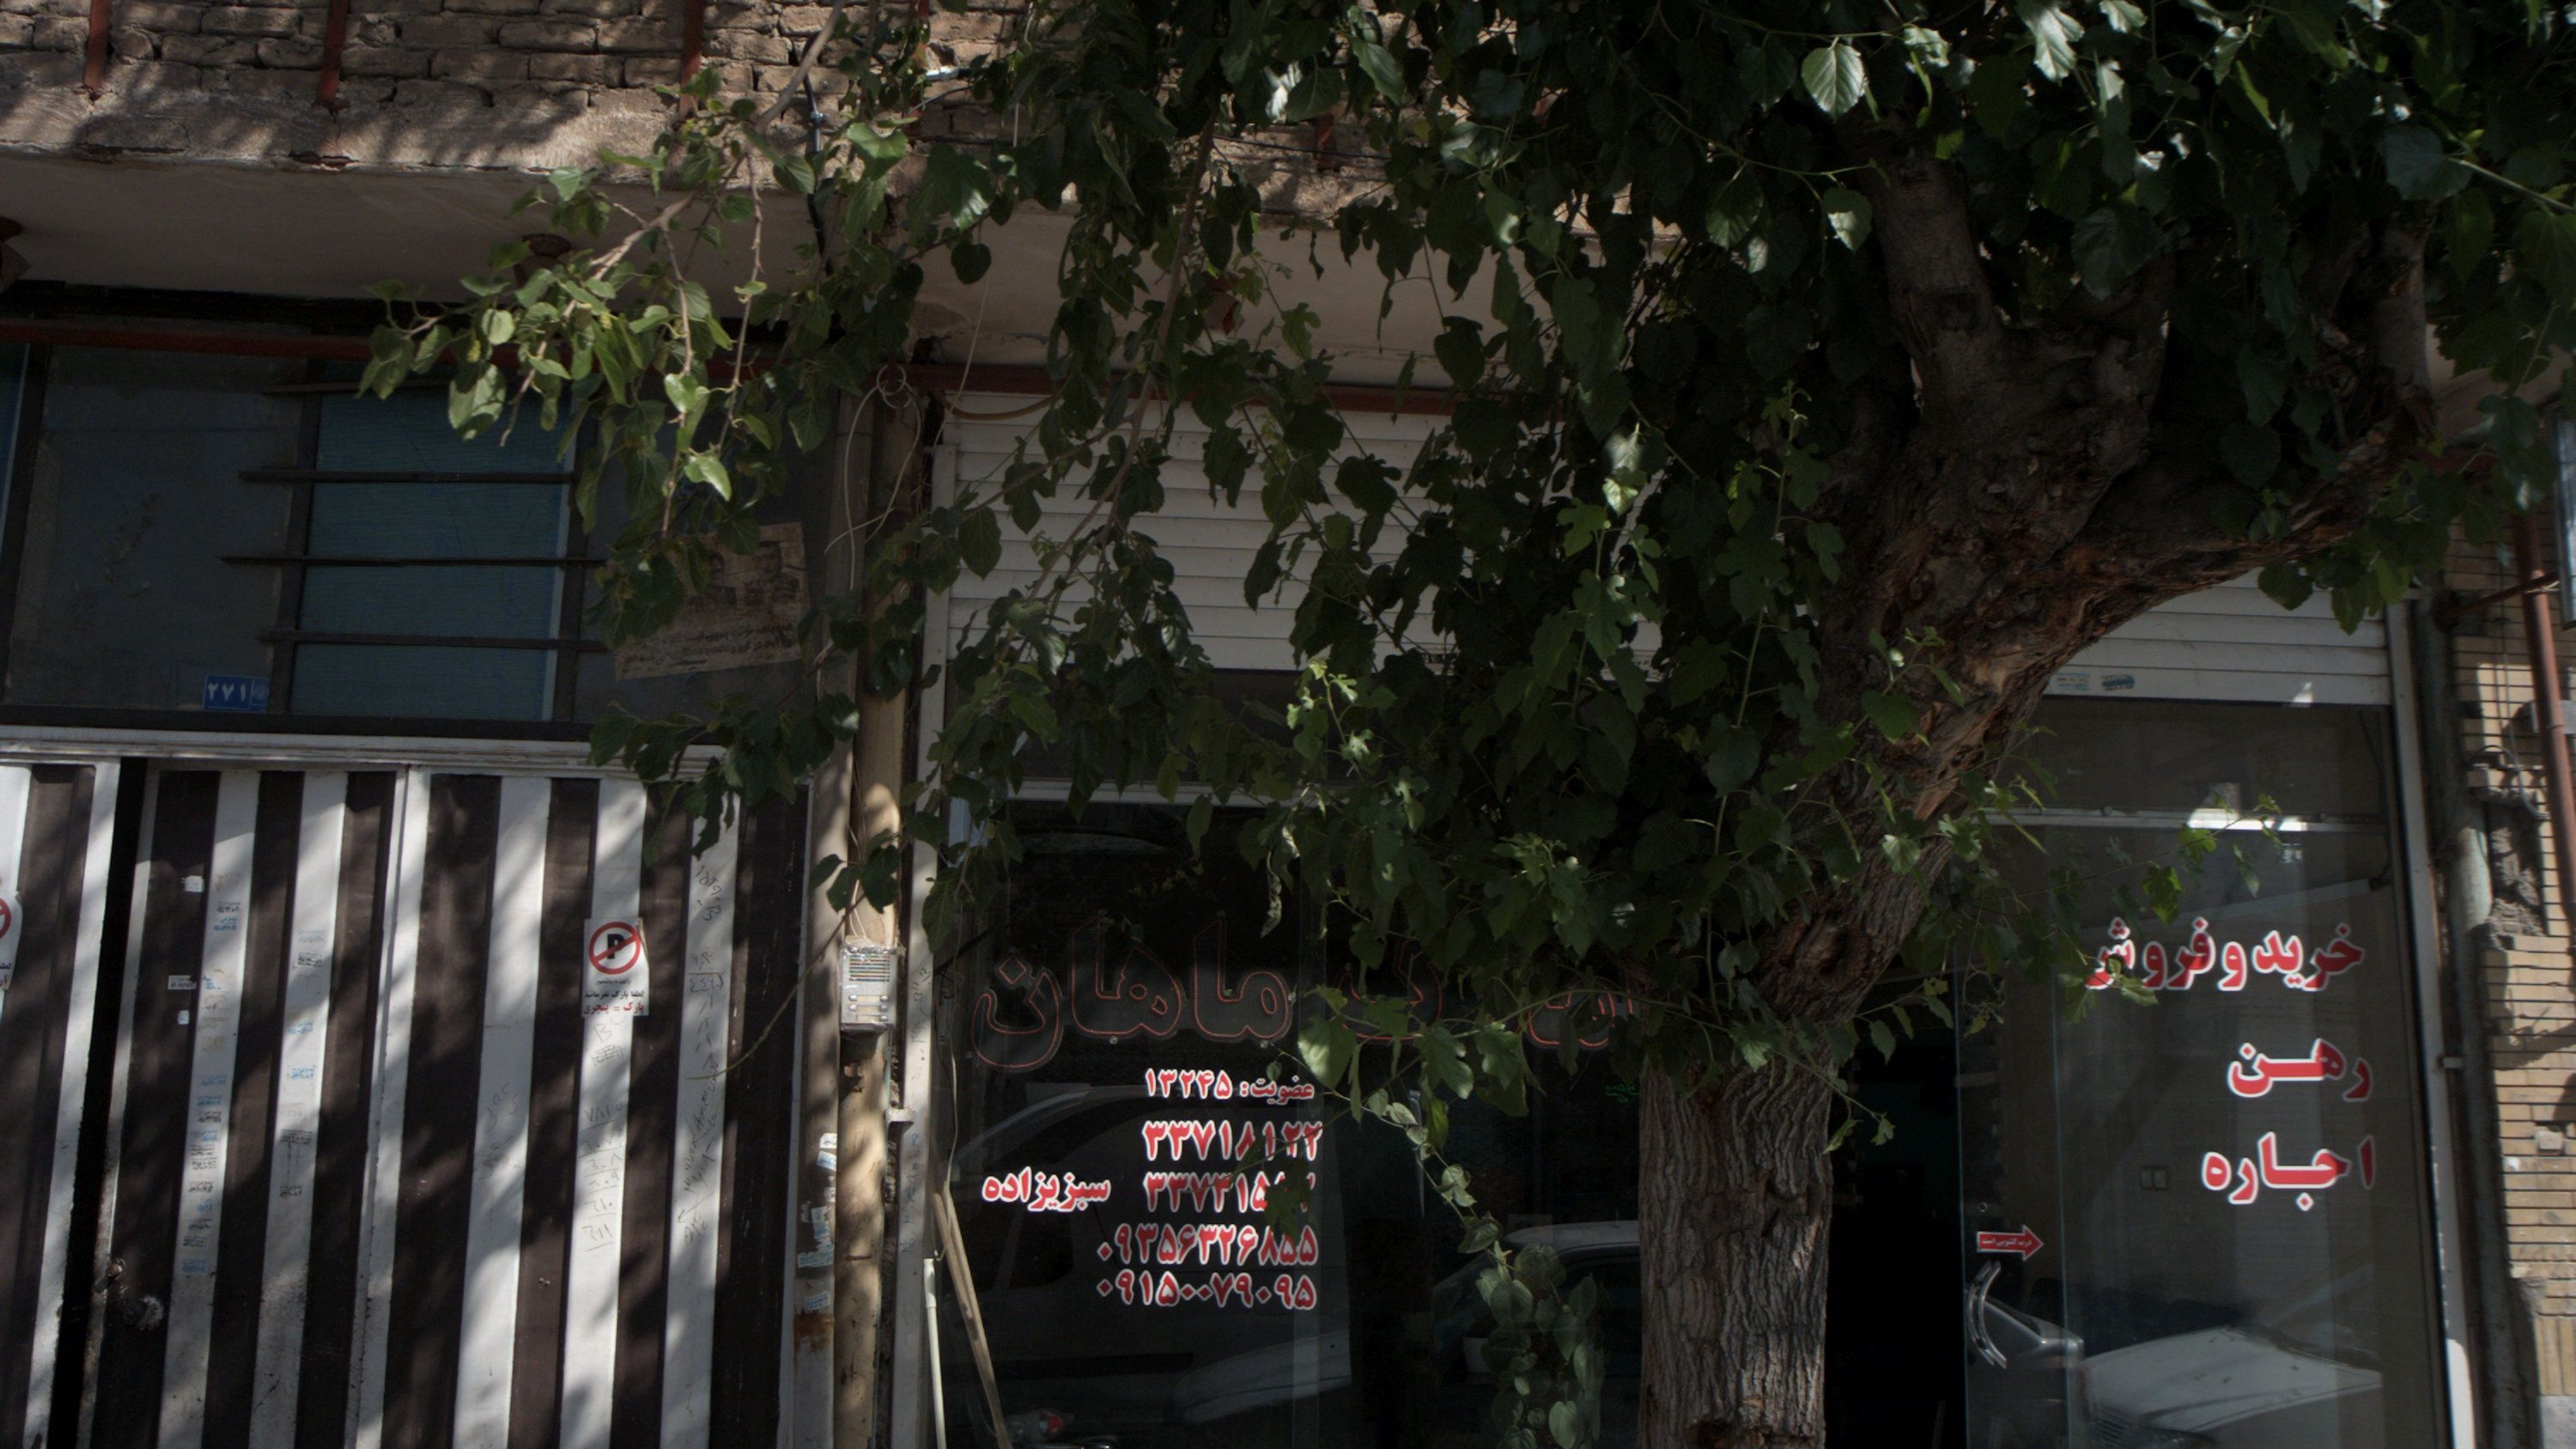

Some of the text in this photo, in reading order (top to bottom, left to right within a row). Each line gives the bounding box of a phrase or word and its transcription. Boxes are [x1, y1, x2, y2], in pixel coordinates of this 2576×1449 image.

[207, 681, 247, 703] ۲۷۱
[607, 934, 624, 959] P
[971, 912, 1290, 1069] ماهان
[1144, 1066, 1234, 1100] ۱۳۲۴۵
[2227, 1037, 2374, 1102] رهن
[1142, 1170, 1316, 1214] ۳۳۷۳۱۵
[2201, 1130, 2376, 1211] اجاره
[1096, 1268, 1319, 1312] ۰۹۱۵۰۰۷۹۰۹۵
